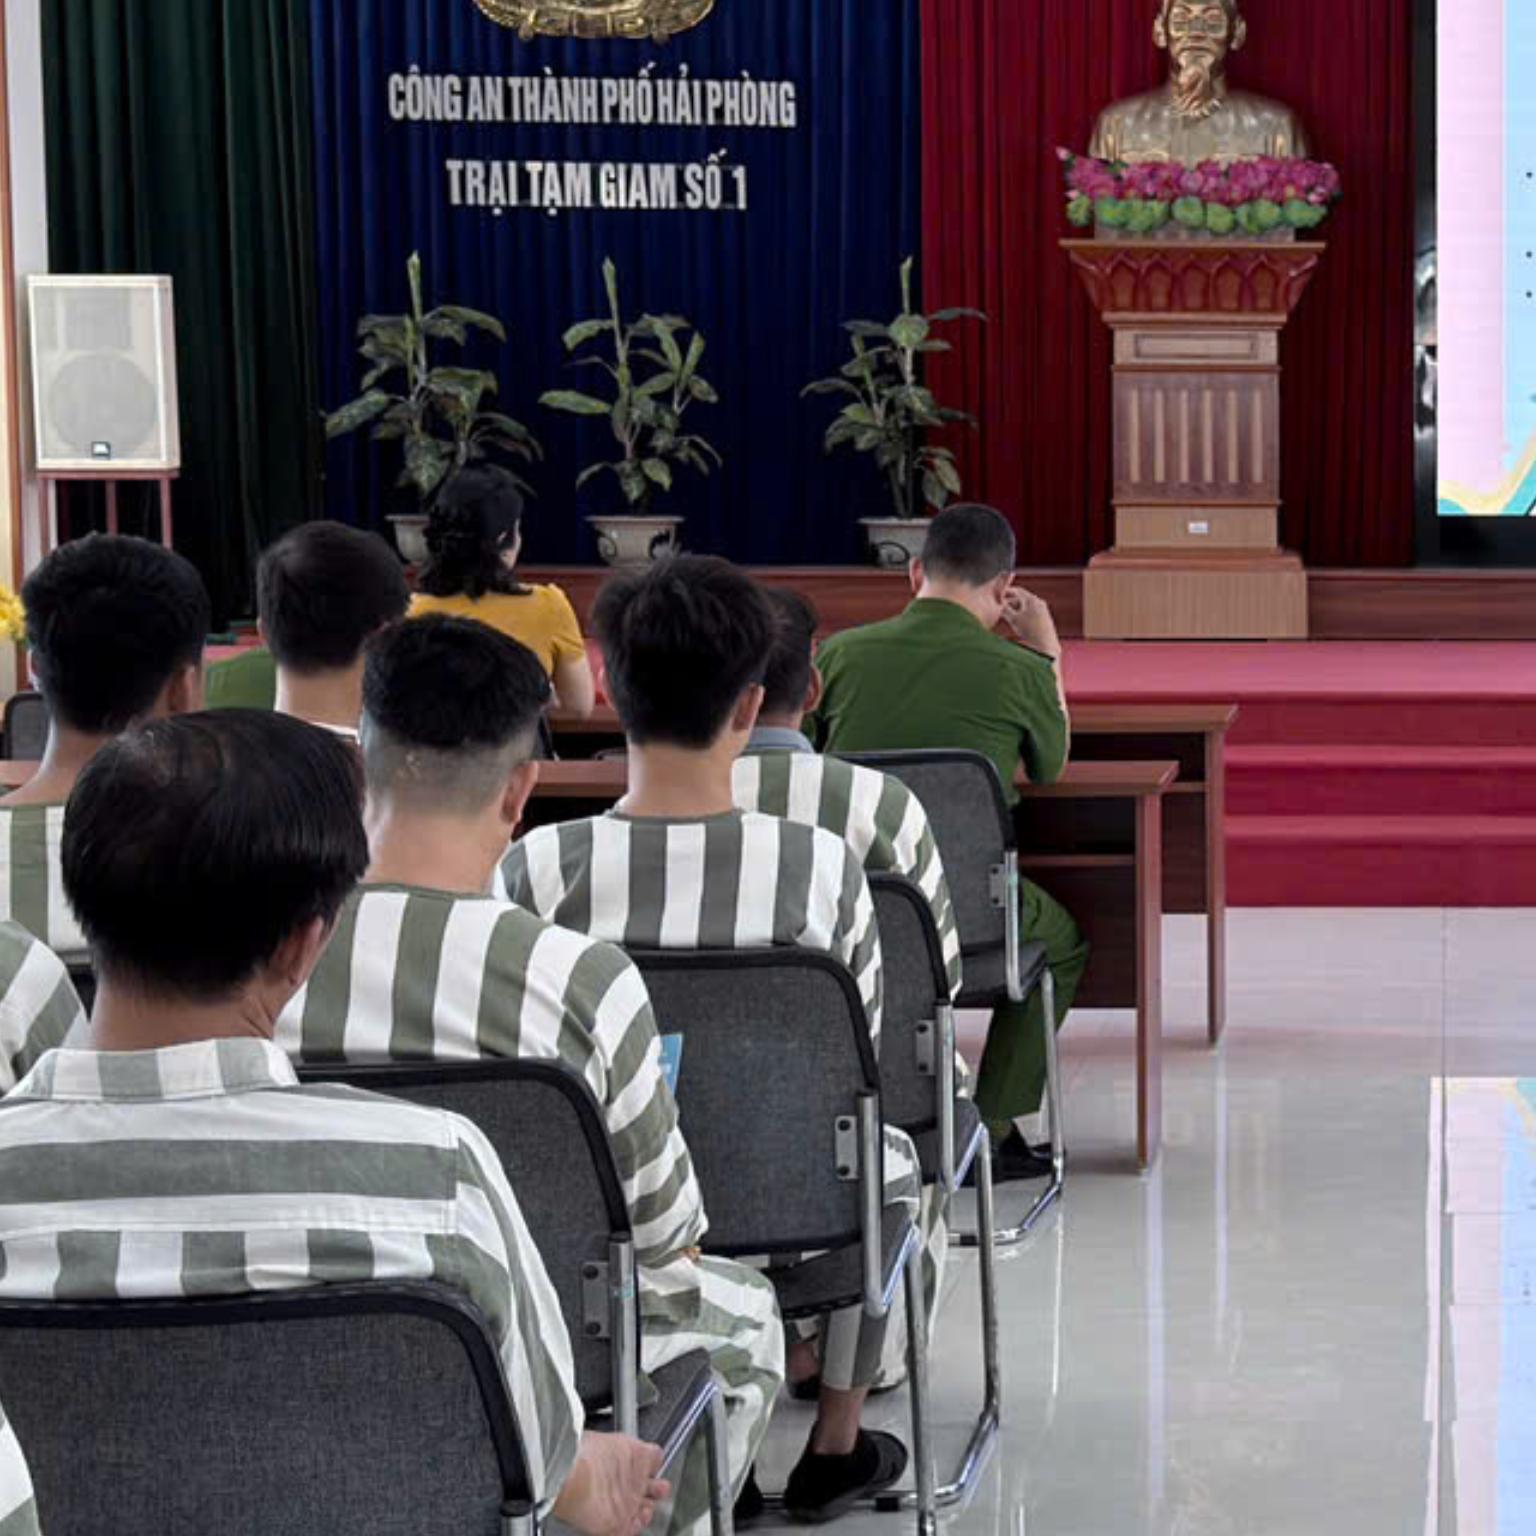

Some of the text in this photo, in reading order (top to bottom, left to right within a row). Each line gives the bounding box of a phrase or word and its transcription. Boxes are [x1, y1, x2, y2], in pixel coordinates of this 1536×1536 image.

[388, 61, 796, 127] CÔNG AN THÀNH PHỐ HẢI PHÒNG
[446, 148, 746, 216] TRẠI TẠM GIAM SỐ 1
